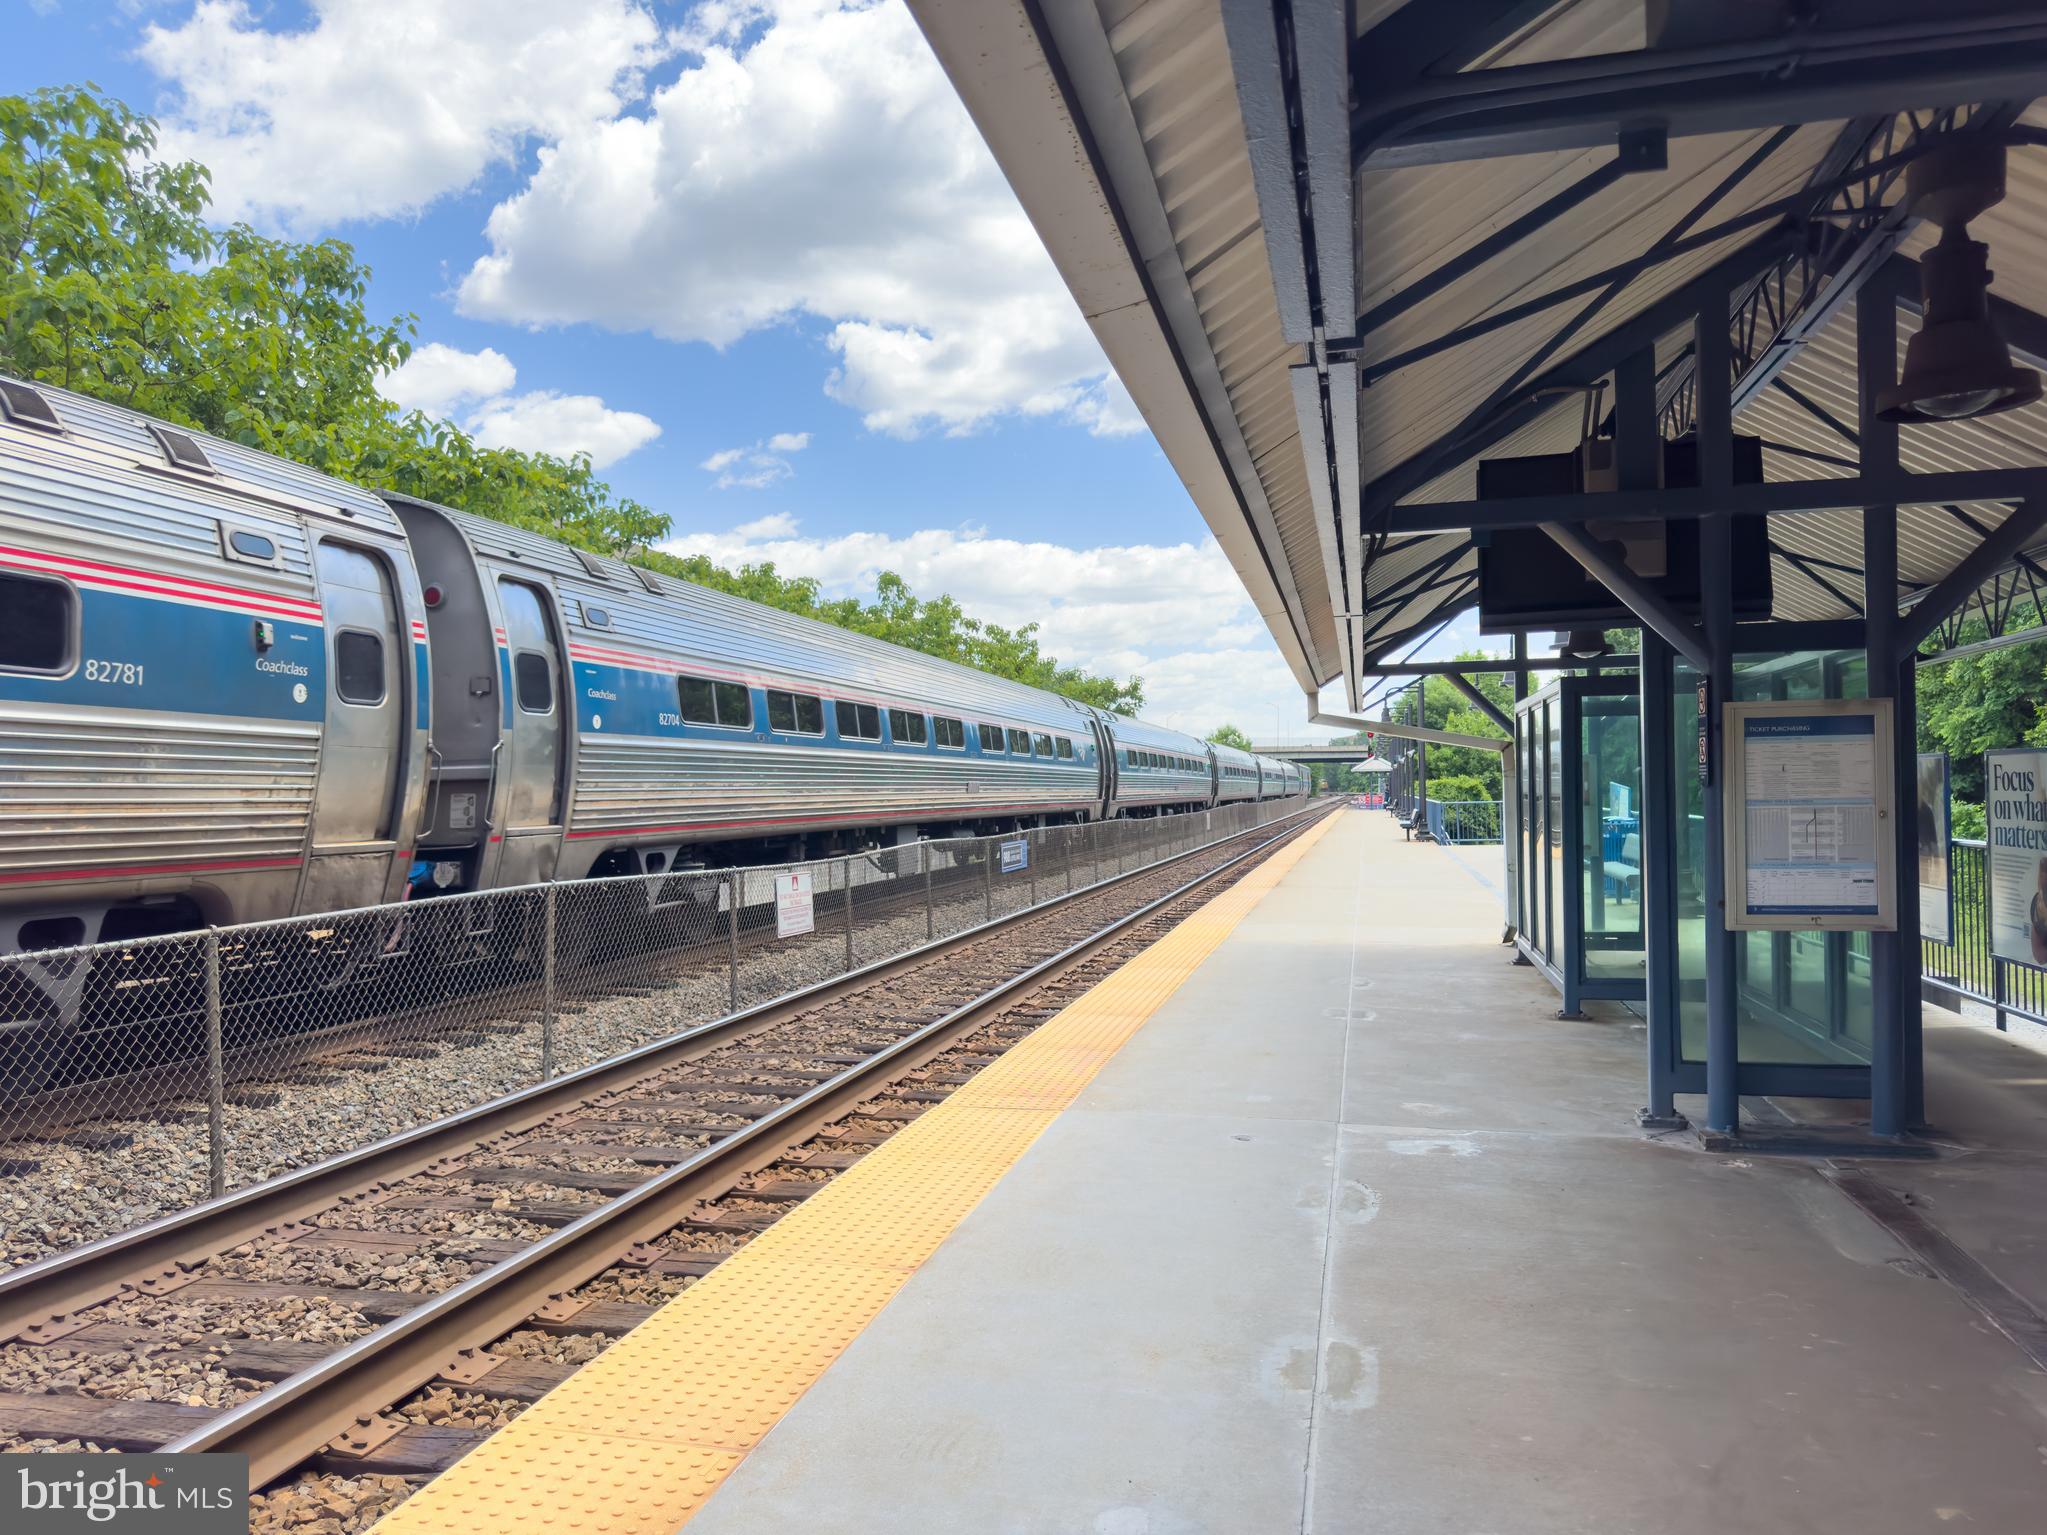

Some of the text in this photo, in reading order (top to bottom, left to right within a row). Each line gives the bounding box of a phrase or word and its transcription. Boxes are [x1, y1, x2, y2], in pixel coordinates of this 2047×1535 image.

[85, 659, 144, 686] 82781
[255, 658, 309, 677] Coachclass
[587, 687, 617, 701] Coachclass
[658, 712, 680, 726] 82704
[1994, 764, 2035, 792] Focus
[1994, 799, 2011, 820] on
